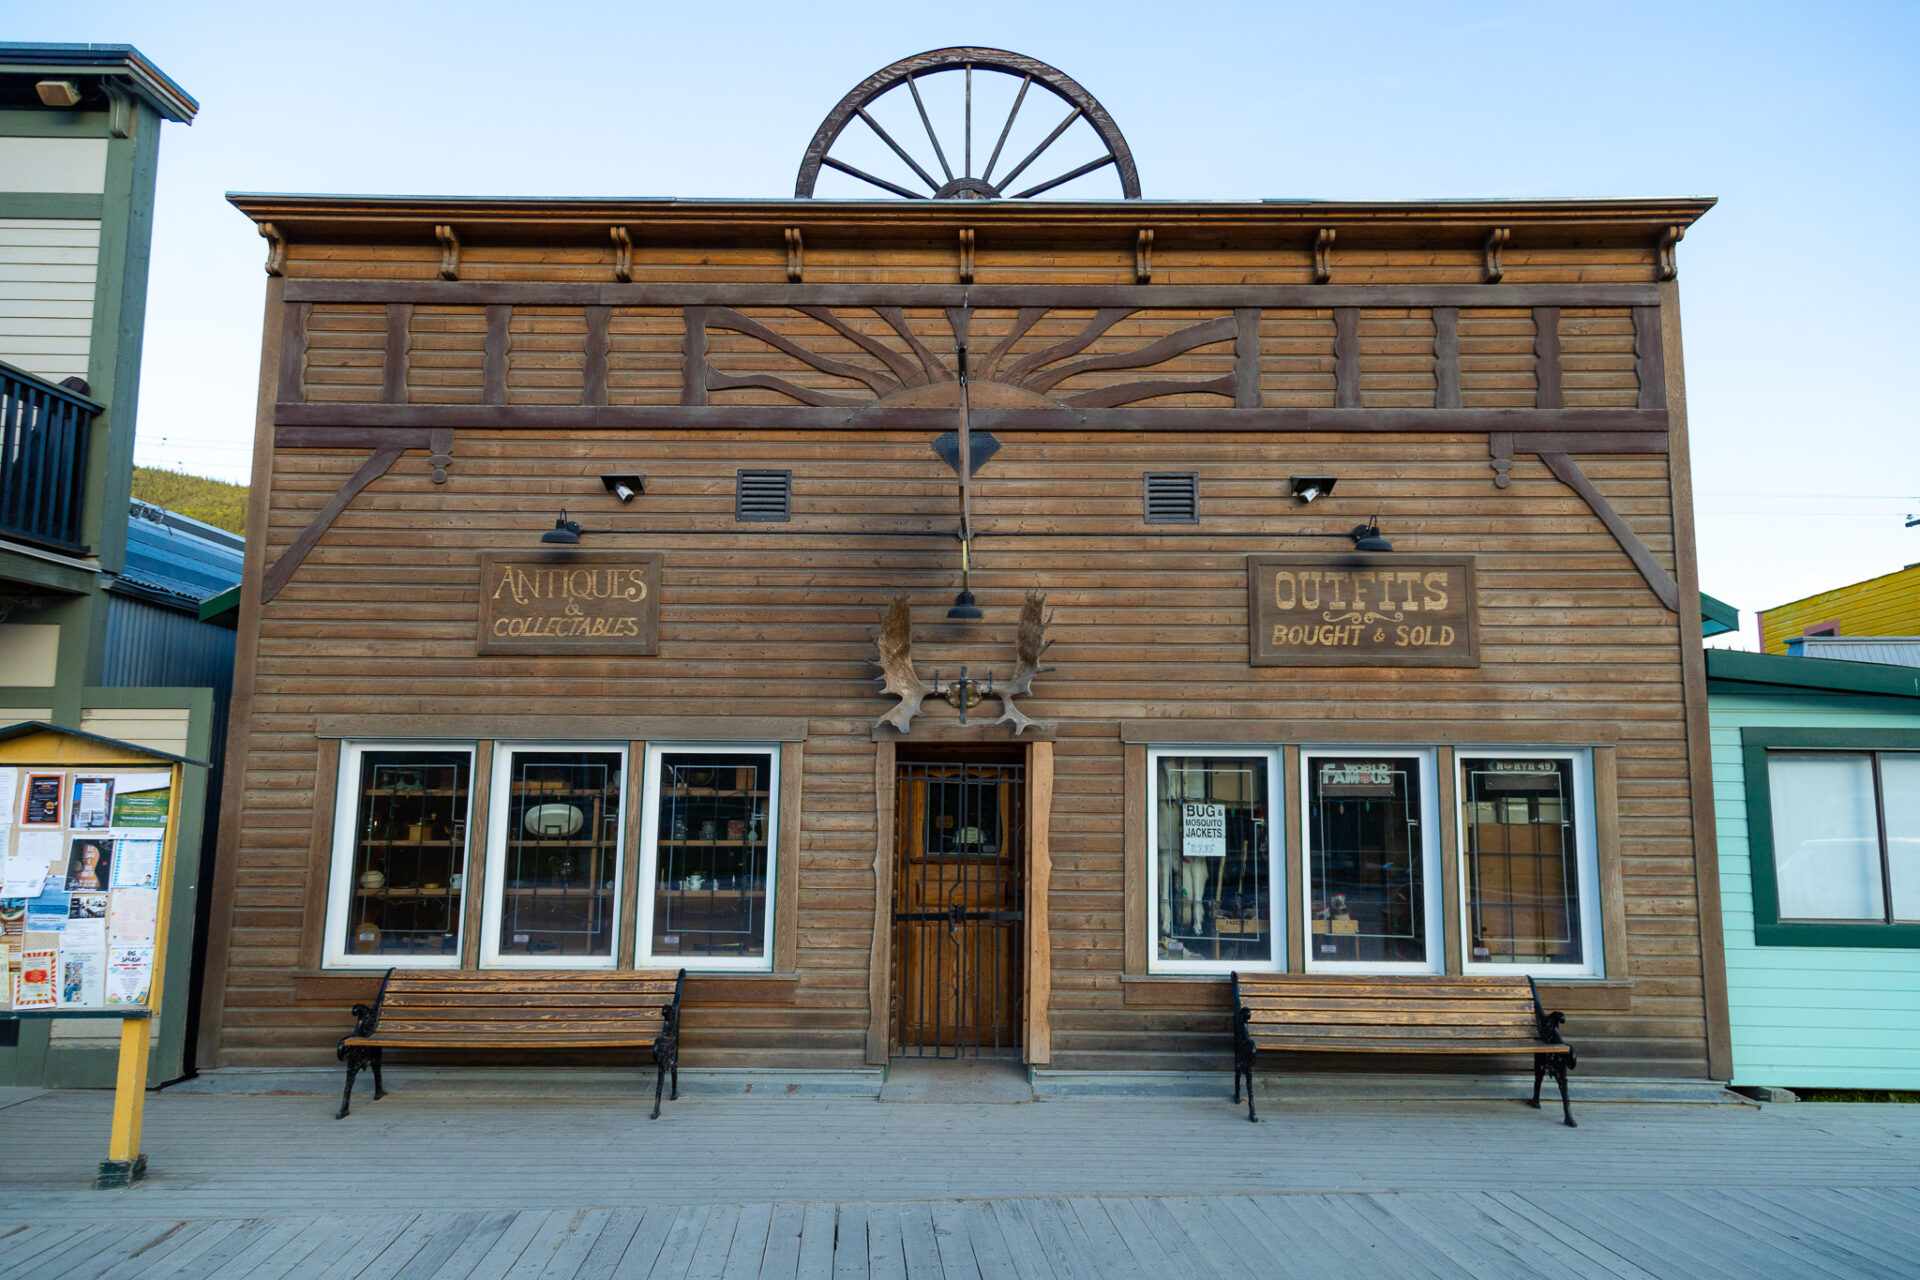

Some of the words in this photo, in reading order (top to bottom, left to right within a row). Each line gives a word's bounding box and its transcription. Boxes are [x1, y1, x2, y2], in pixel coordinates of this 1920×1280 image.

[492, 565, 648, 605] ANTIQUES
[1275, 571, 1449, 611] OUTFITS
[564, 597, 584, 616] &
[493, 617, 640, 637] COLLECTABLES
[1271, 624, 1366, 646] BOUGHT
[1372, 627, 1386, 643] &
[1394, 625, 1455, 646] SOLD
[1344, 763, 1389, 772] WORLD
[1186, 804, 1216, 817] BUG
[1217, 809, 1223, 817] &
[1185, 819, 1223, 827] MOSQUITO
[1186, 828, 1223, 838] JACKETS
